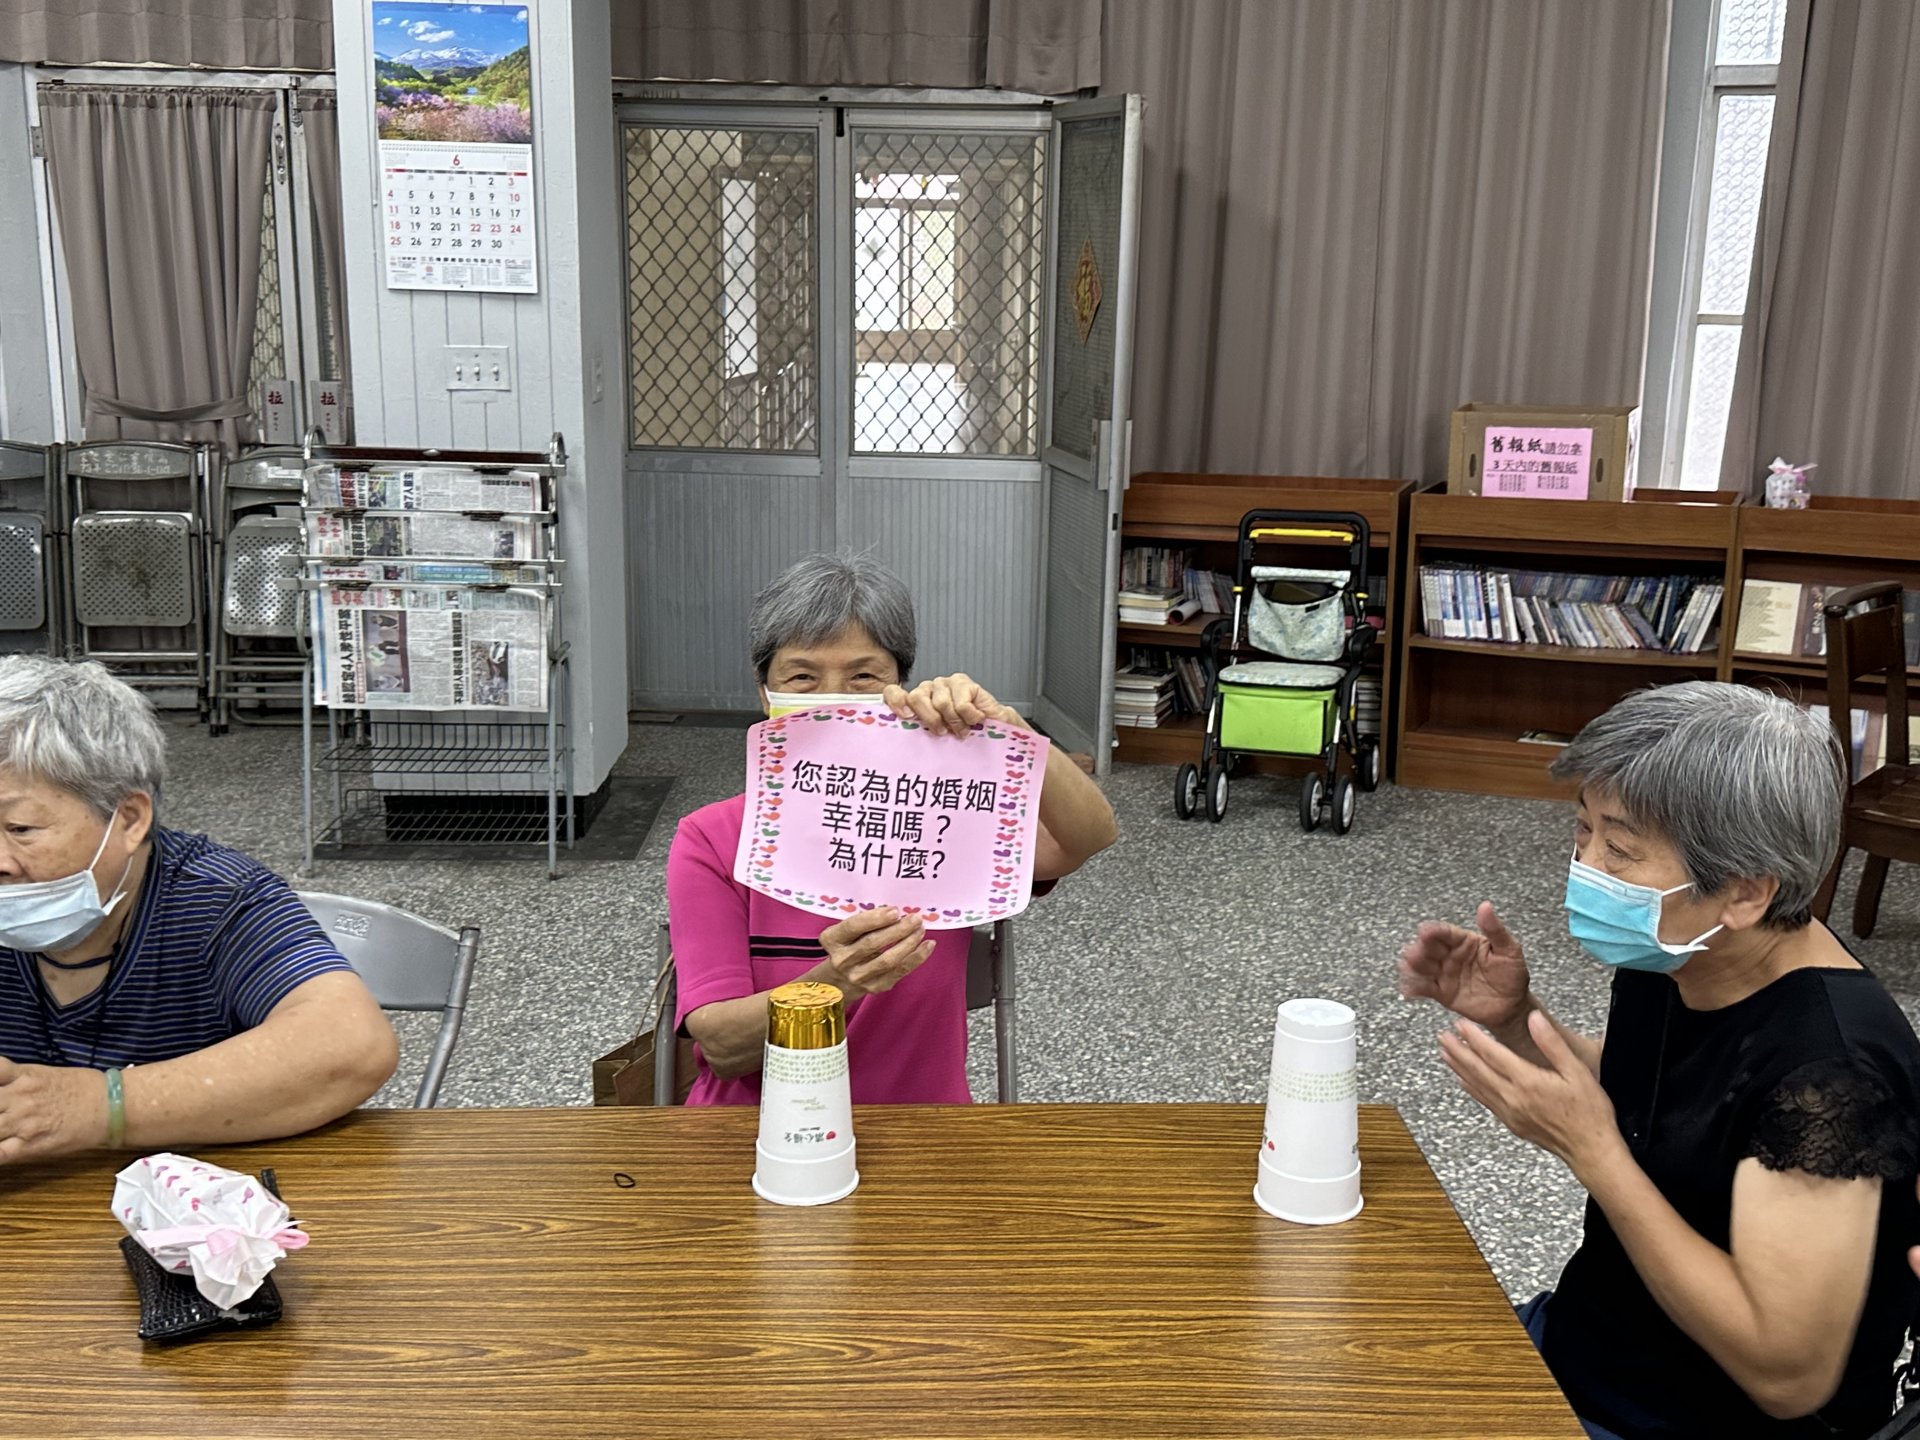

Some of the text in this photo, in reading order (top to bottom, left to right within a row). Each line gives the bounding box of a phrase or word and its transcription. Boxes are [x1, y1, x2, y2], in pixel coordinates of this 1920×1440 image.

[453, 155, 461, 166] 6
[508, 178, 514, 186] 3
[489, 193, 494, 201] 9
[510, 194, 520, 202] 10
[389, 206, 398, 214] 11
[410, 206, 420, 214] 12
[430, 207, 440, 215] 13
[450, 208, 461, 216] 14
[471, 208, 480, 217] 15
[491, 209, 500, 217] 16
[390, 221, 400, 229] 18
[411, 222, 420, 230] 19
[431, 223, 441, 231] 20
[451, 223, 460, 231] 21
[471, 224, 481, 232] 22
[511, 225, 521, 233] 24
[390, 237, 401, 245] 25
[411, 238, 421, 246] 26
[432, 238, 442, 246] 27
[452, 239, 462, 247] 28
[491, 240, 502, 248] 30
[268, 391, 284, 405] 拉
[320, 392, 337, 405] 拉
[792, 759, 997, 813] 您認為的婚姻
[827, 837, 946, 880] 為什麼?
